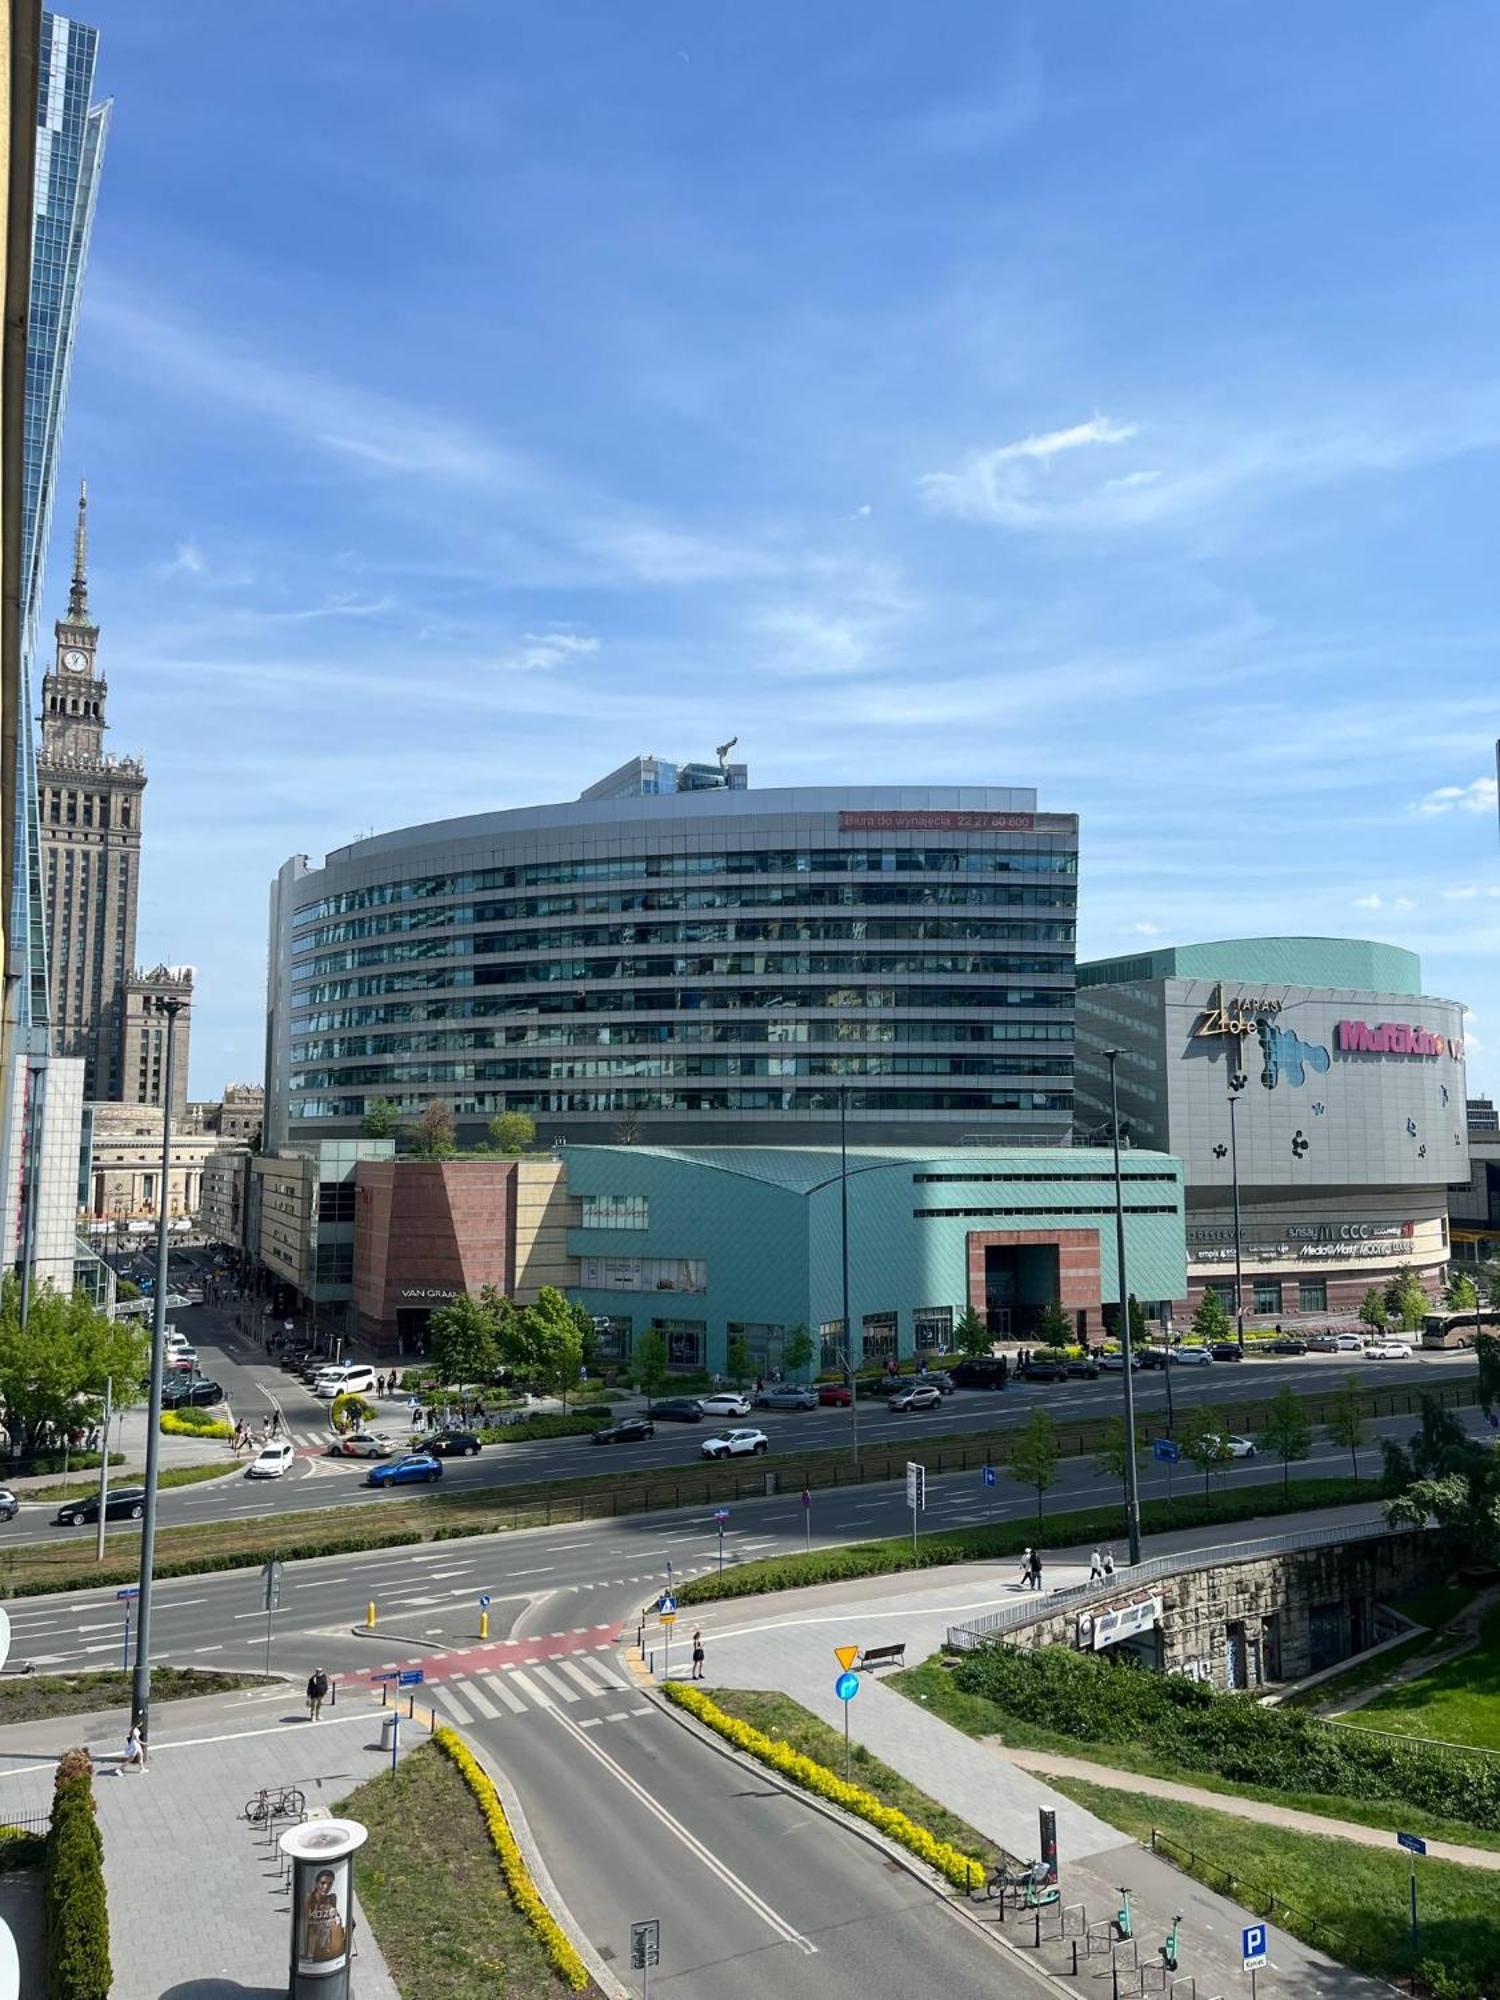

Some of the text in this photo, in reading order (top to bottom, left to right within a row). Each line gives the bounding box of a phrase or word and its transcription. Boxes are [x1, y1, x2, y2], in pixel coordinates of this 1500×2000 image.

[878, 815, 893, 826] do
[1339, 1019, 1444, 1056] Multikino
[1197, 1230, 1248, 1240] RESERVD
[1340, 1225, 1369, 1239] CCC
[401, 1289, 425, 1297] VAN
[1248, 1929, 1261, 1954] P
